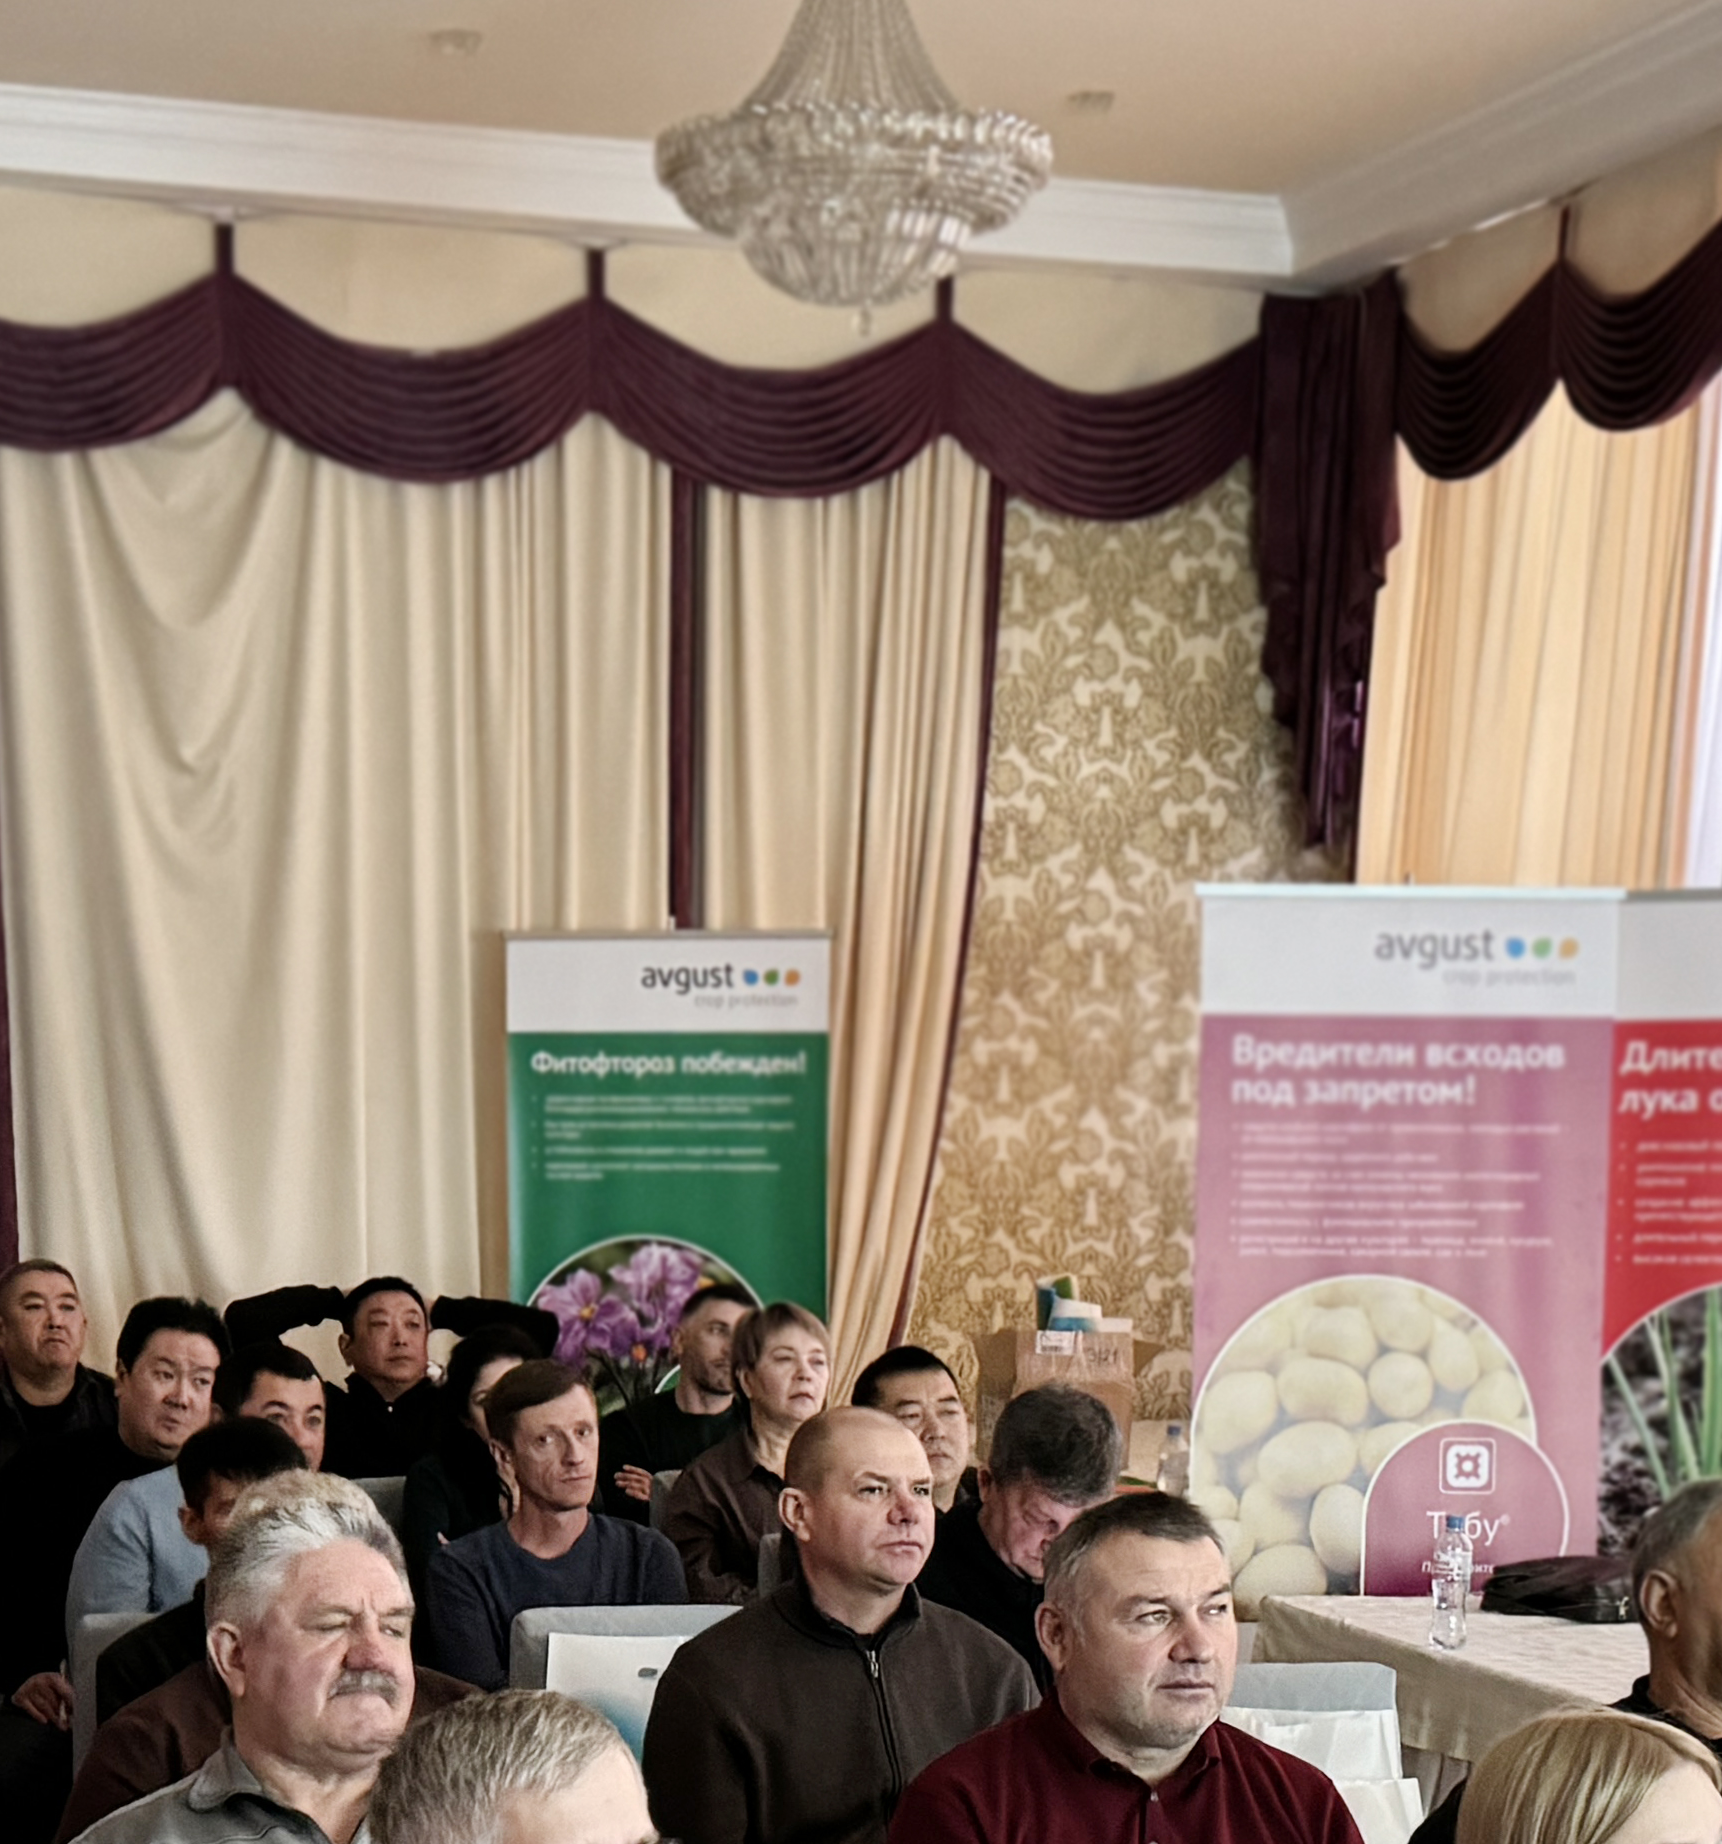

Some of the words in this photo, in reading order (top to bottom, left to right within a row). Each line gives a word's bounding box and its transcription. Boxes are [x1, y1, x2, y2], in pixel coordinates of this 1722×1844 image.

[1374, 927, 1494, 971] avgust
[641, 963, 735, 996] avgust
[531, 1050, 675, 1080] Фитофтороз
[1232, 1034, 1415, 1072] Вредители
[1425, 1042, 1566, 1070] всходов
[1231, 1078, 1296, 1108] под
[1304, 1073, 1478, 1112] запретом!
[1618, 1088, 1698, 1121] лука
[1426, 1511, 1500, 1546] Тбу
